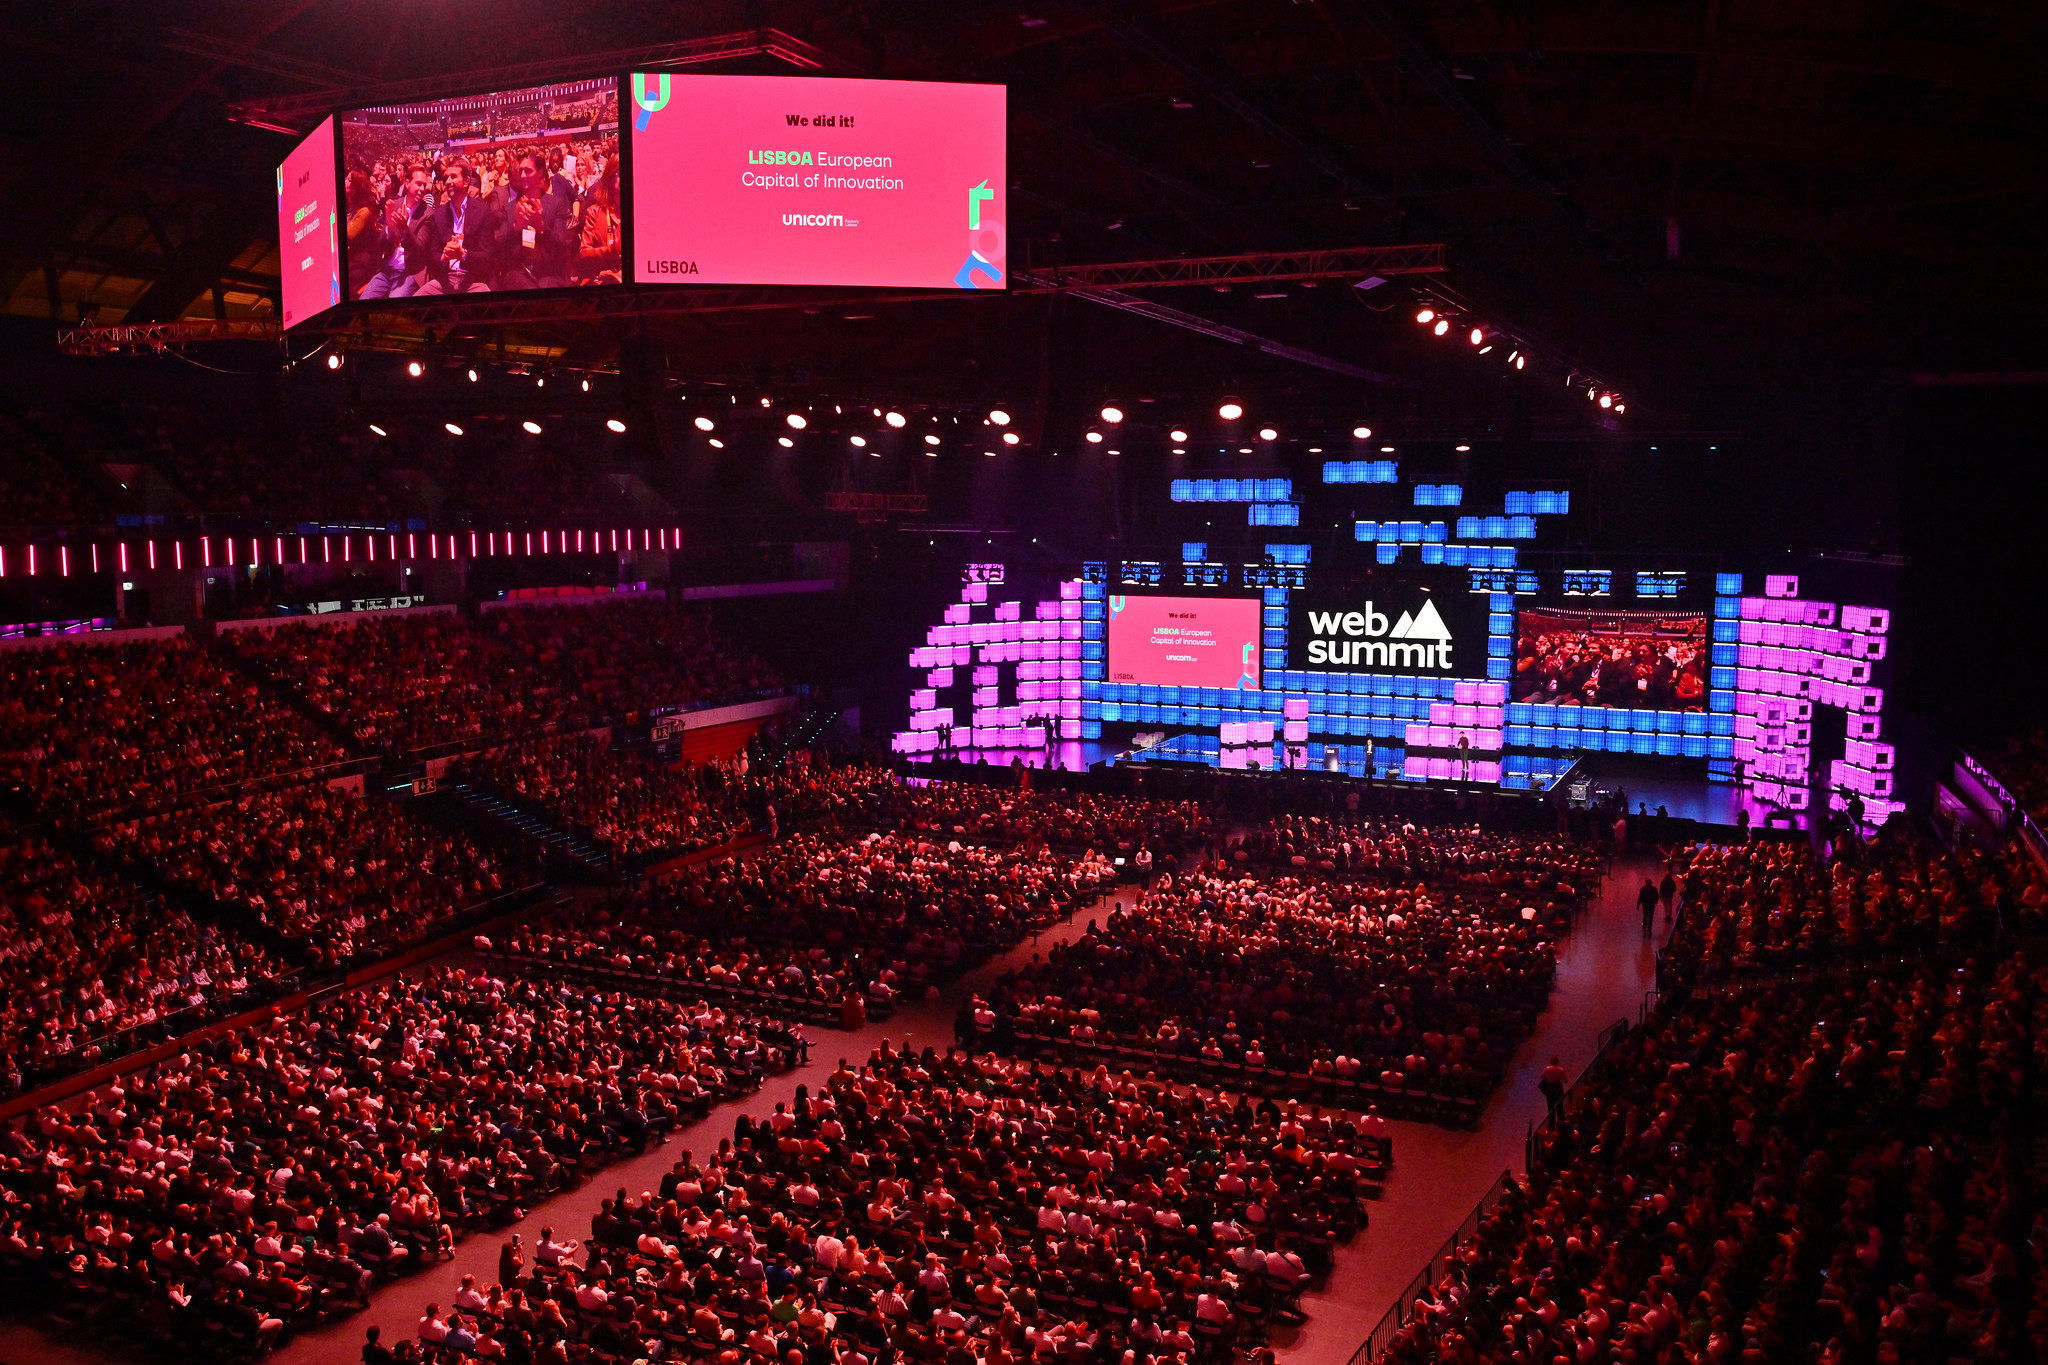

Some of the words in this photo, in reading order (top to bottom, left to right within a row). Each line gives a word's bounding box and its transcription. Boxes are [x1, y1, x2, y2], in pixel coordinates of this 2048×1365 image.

[786, 115, 808, 127] We
[813, 115, 835, 127] did
[839, 115, 855, 128] it!
[749, 150, 813, 166] LISBOA
[818, 152, 892, 170] European
[741, 171, 799, 190] Capital
[804, 173, 819, 188] of
[824, 174, 904, 190] Innovation
[782, 213, 843, 227] unicorn
[648, 260, 699, 275] LISBOA
[1308, 601, 1388, 637] web
[1180, 629, 1211, 637] European
[1150, 637, 1174, 645] Capital
[1175, 637, 1182, 645] of
[1308, 638, 1453, 669] summit
